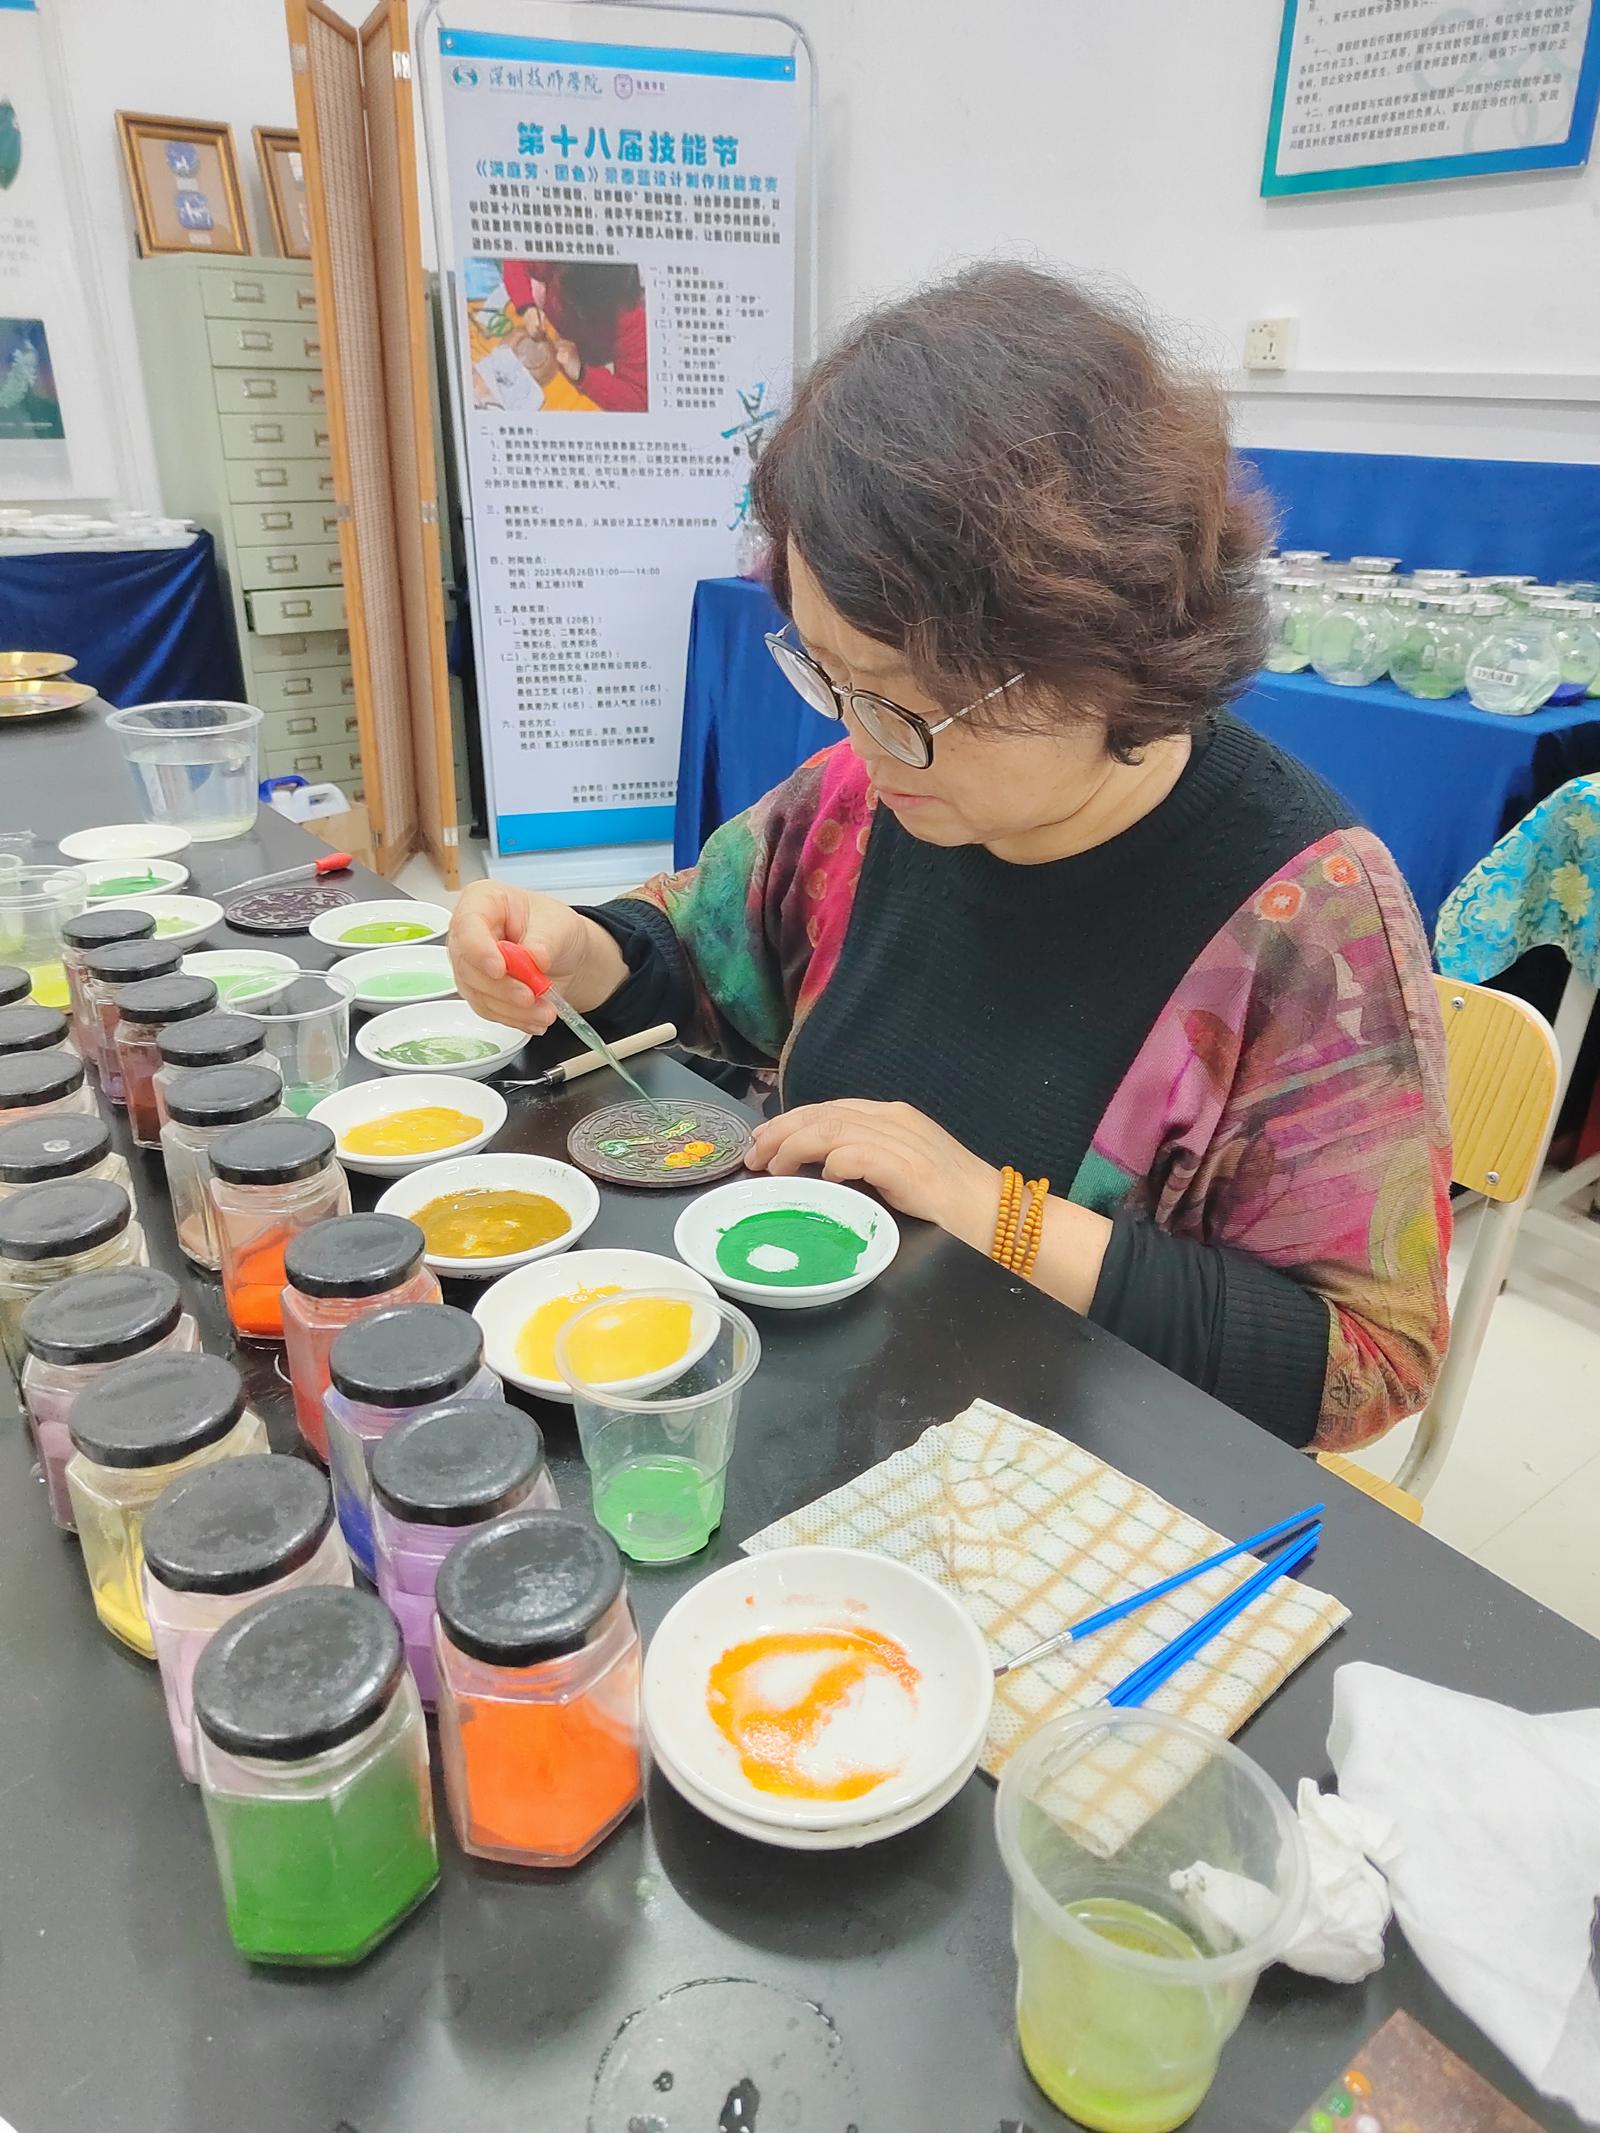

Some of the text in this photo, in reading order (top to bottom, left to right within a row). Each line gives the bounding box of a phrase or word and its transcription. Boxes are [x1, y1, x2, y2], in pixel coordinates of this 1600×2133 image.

[517, 121, 739, 167] 第十八届技能节
